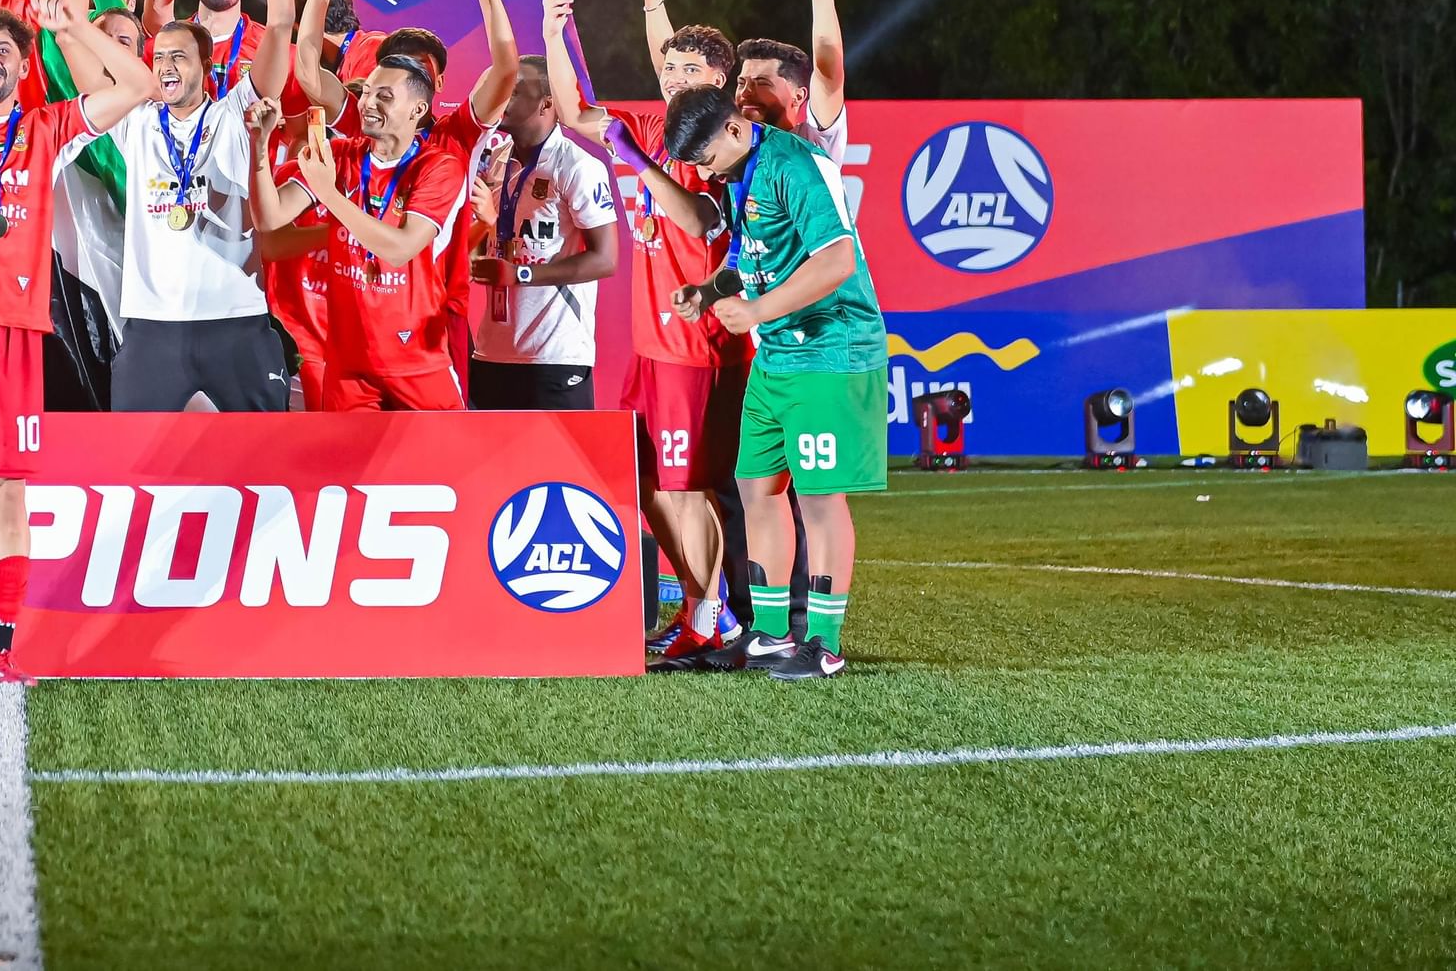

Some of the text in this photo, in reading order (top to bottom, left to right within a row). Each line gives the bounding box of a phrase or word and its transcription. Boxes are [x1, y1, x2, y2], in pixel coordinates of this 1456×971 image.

[941, 193, 1014, 226] ACL
[16, 415, 40, 452] 10
[661, 430, 689, 467] 22
[798, 433, 837, 470] 99
[524, 543, 592, 571] ACL
